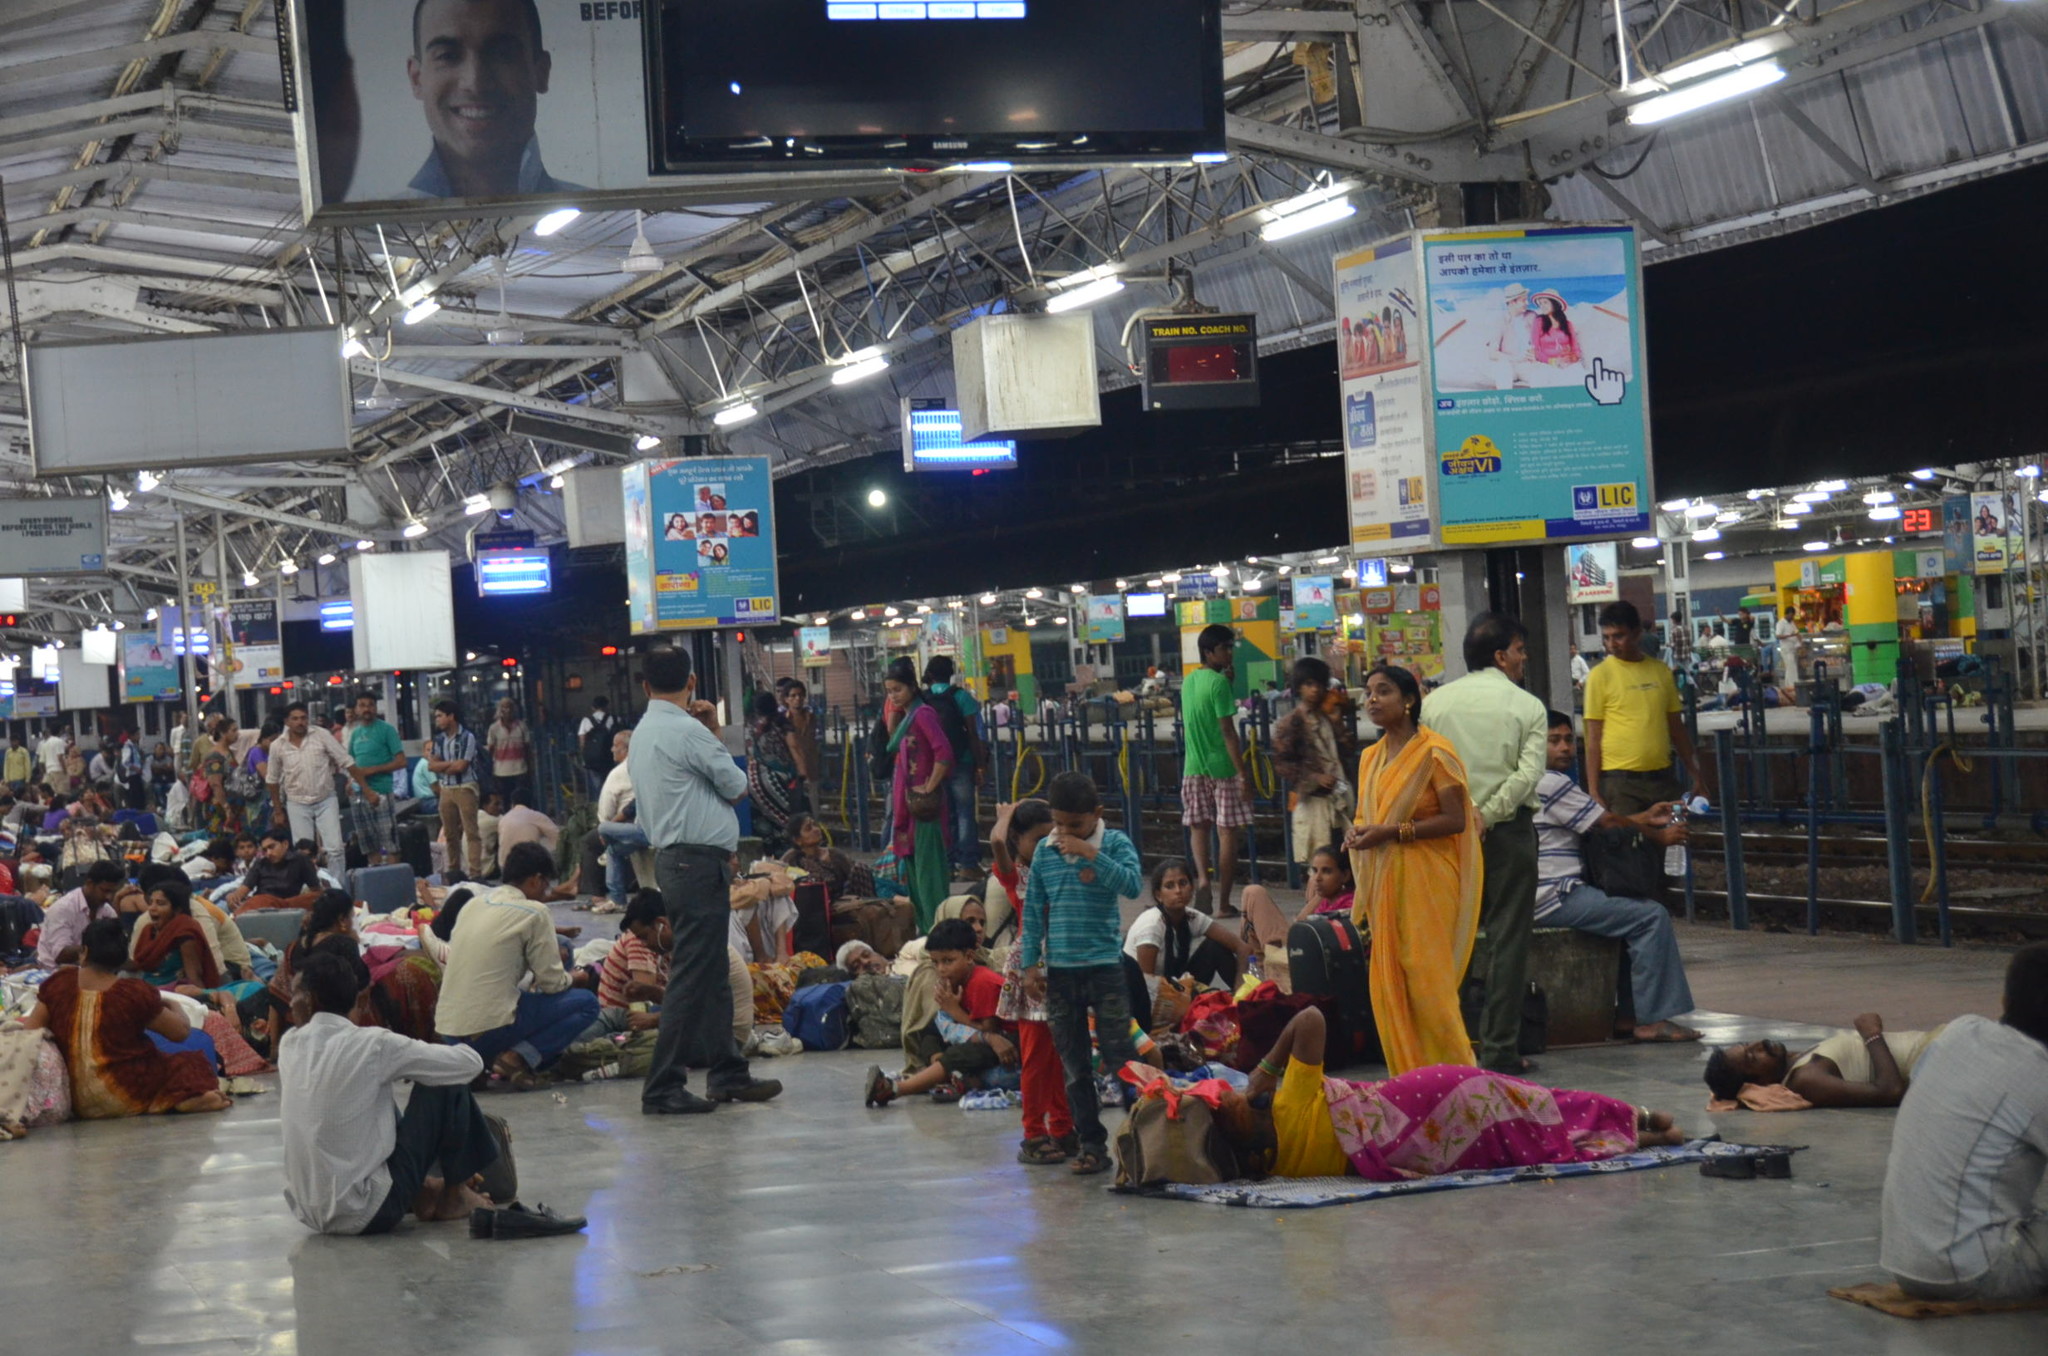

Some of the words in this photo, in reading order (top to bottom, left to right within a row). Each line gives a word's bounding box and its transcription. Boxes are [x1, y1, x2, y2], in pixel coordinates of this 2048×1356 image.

[1440, 266, 1469, 277] आपको
[1472, 265, 1496, 276] हमेशा
[1499, 263, 1509, 274] से
[1152, 327, 1180, 336] TRAIN
[1182, 327, 1198, 335] NO.
[1200, 325, 1231, 334] COACH
[1233, 325, 1248, 333] NO.
[1474, 458, 1493, 472] VI
[1601, 487, 1632, 506] LIC
[1904, 509, 1932, 532] 23
[752, 599, 771, 611] LIC
